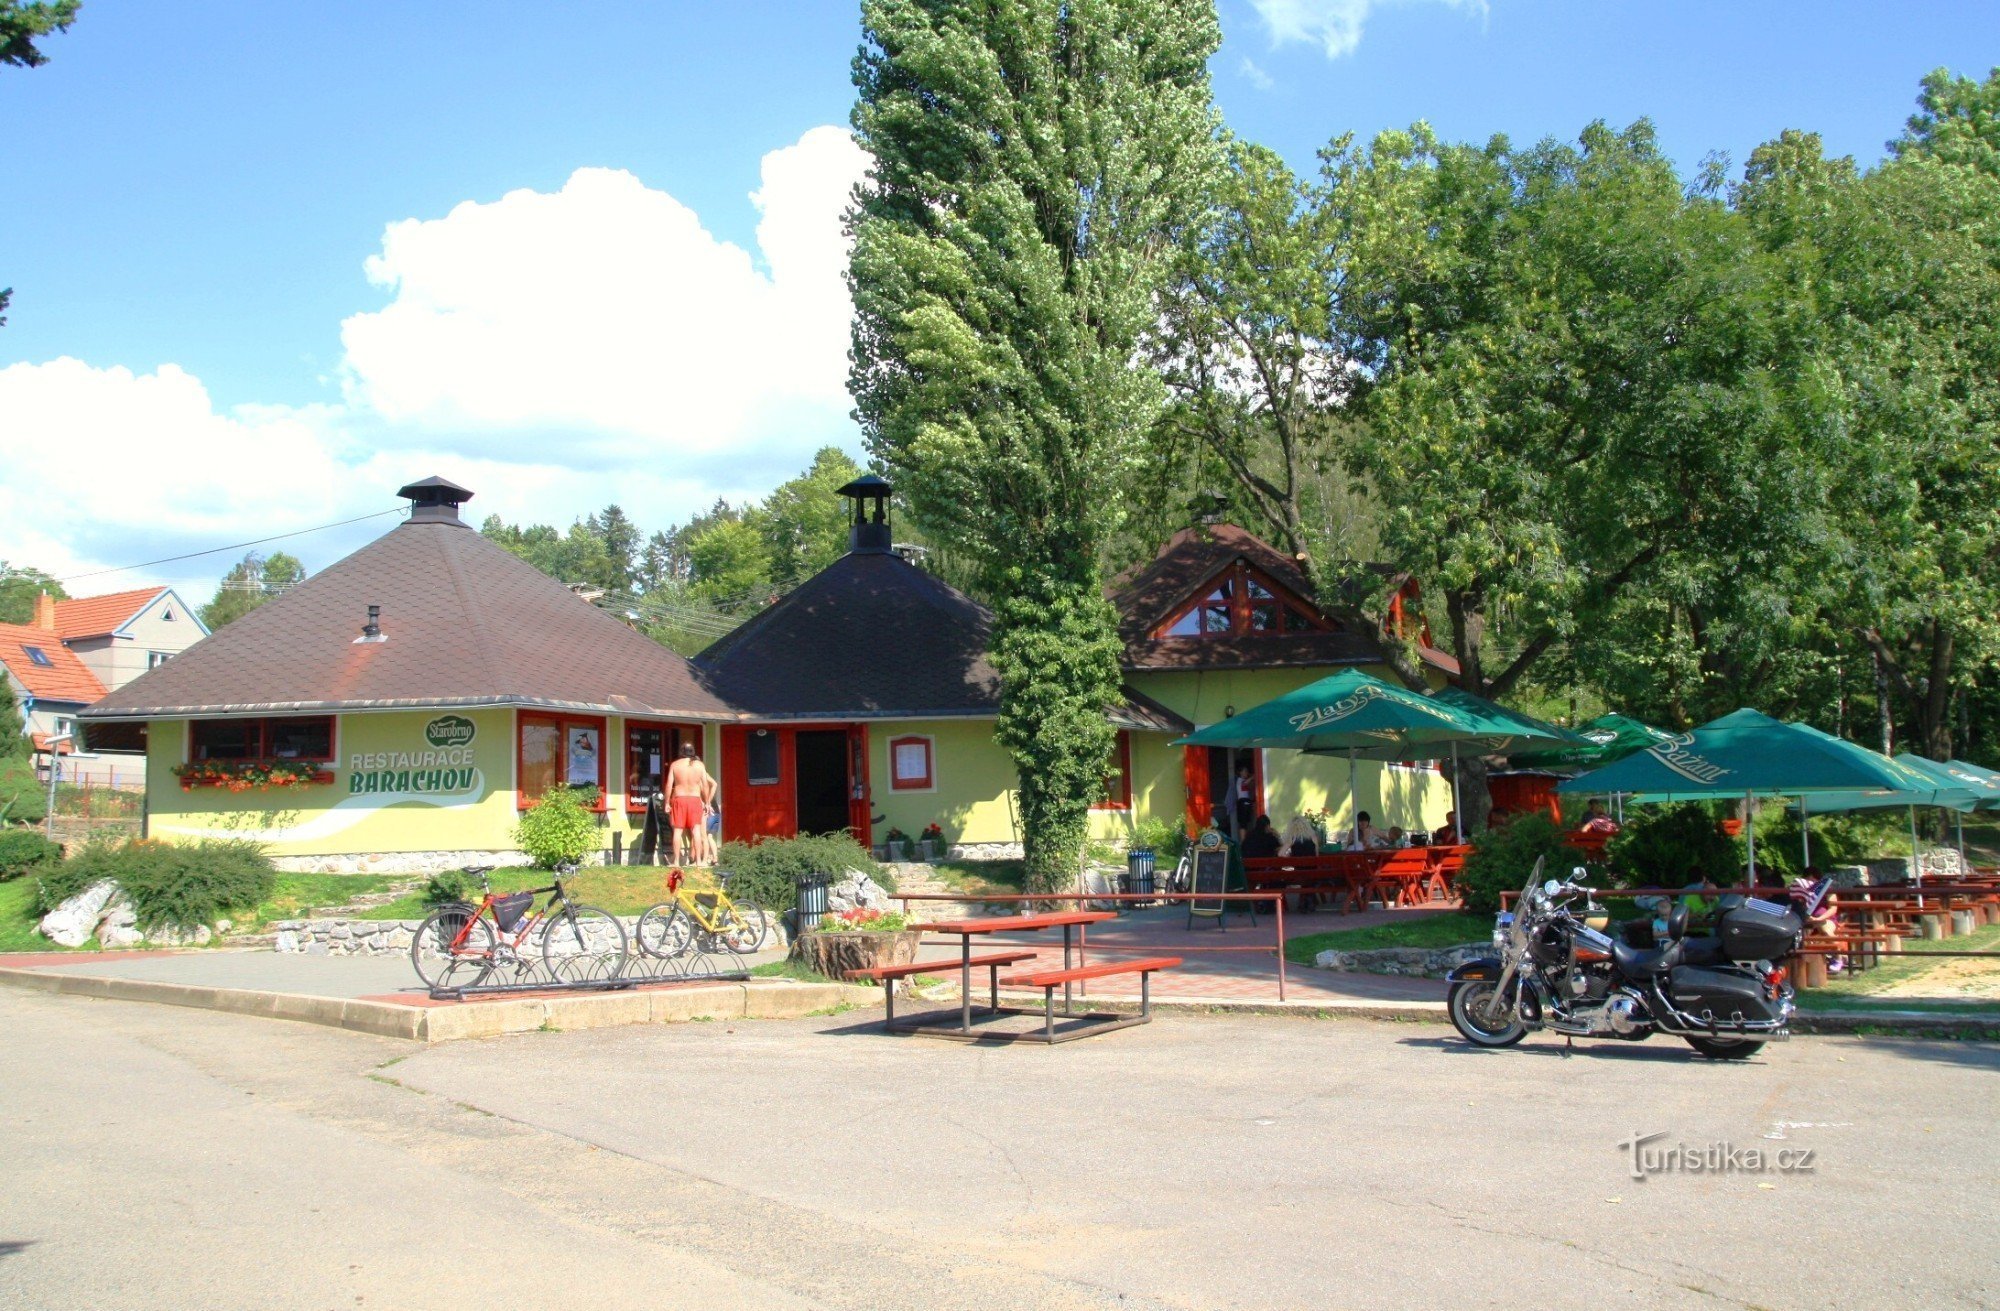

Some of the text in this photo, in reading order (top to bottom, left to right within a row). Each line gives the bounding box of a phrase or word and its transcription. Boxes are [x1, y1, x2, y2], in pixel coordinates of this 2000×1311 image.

[429, 719, 472, 745] Starobrno
[351, 749, 475, 769] RESTAURACE
[1644, 731, 1732, 785] Bažant
[349, 767, 476, 795] BARACHOV
